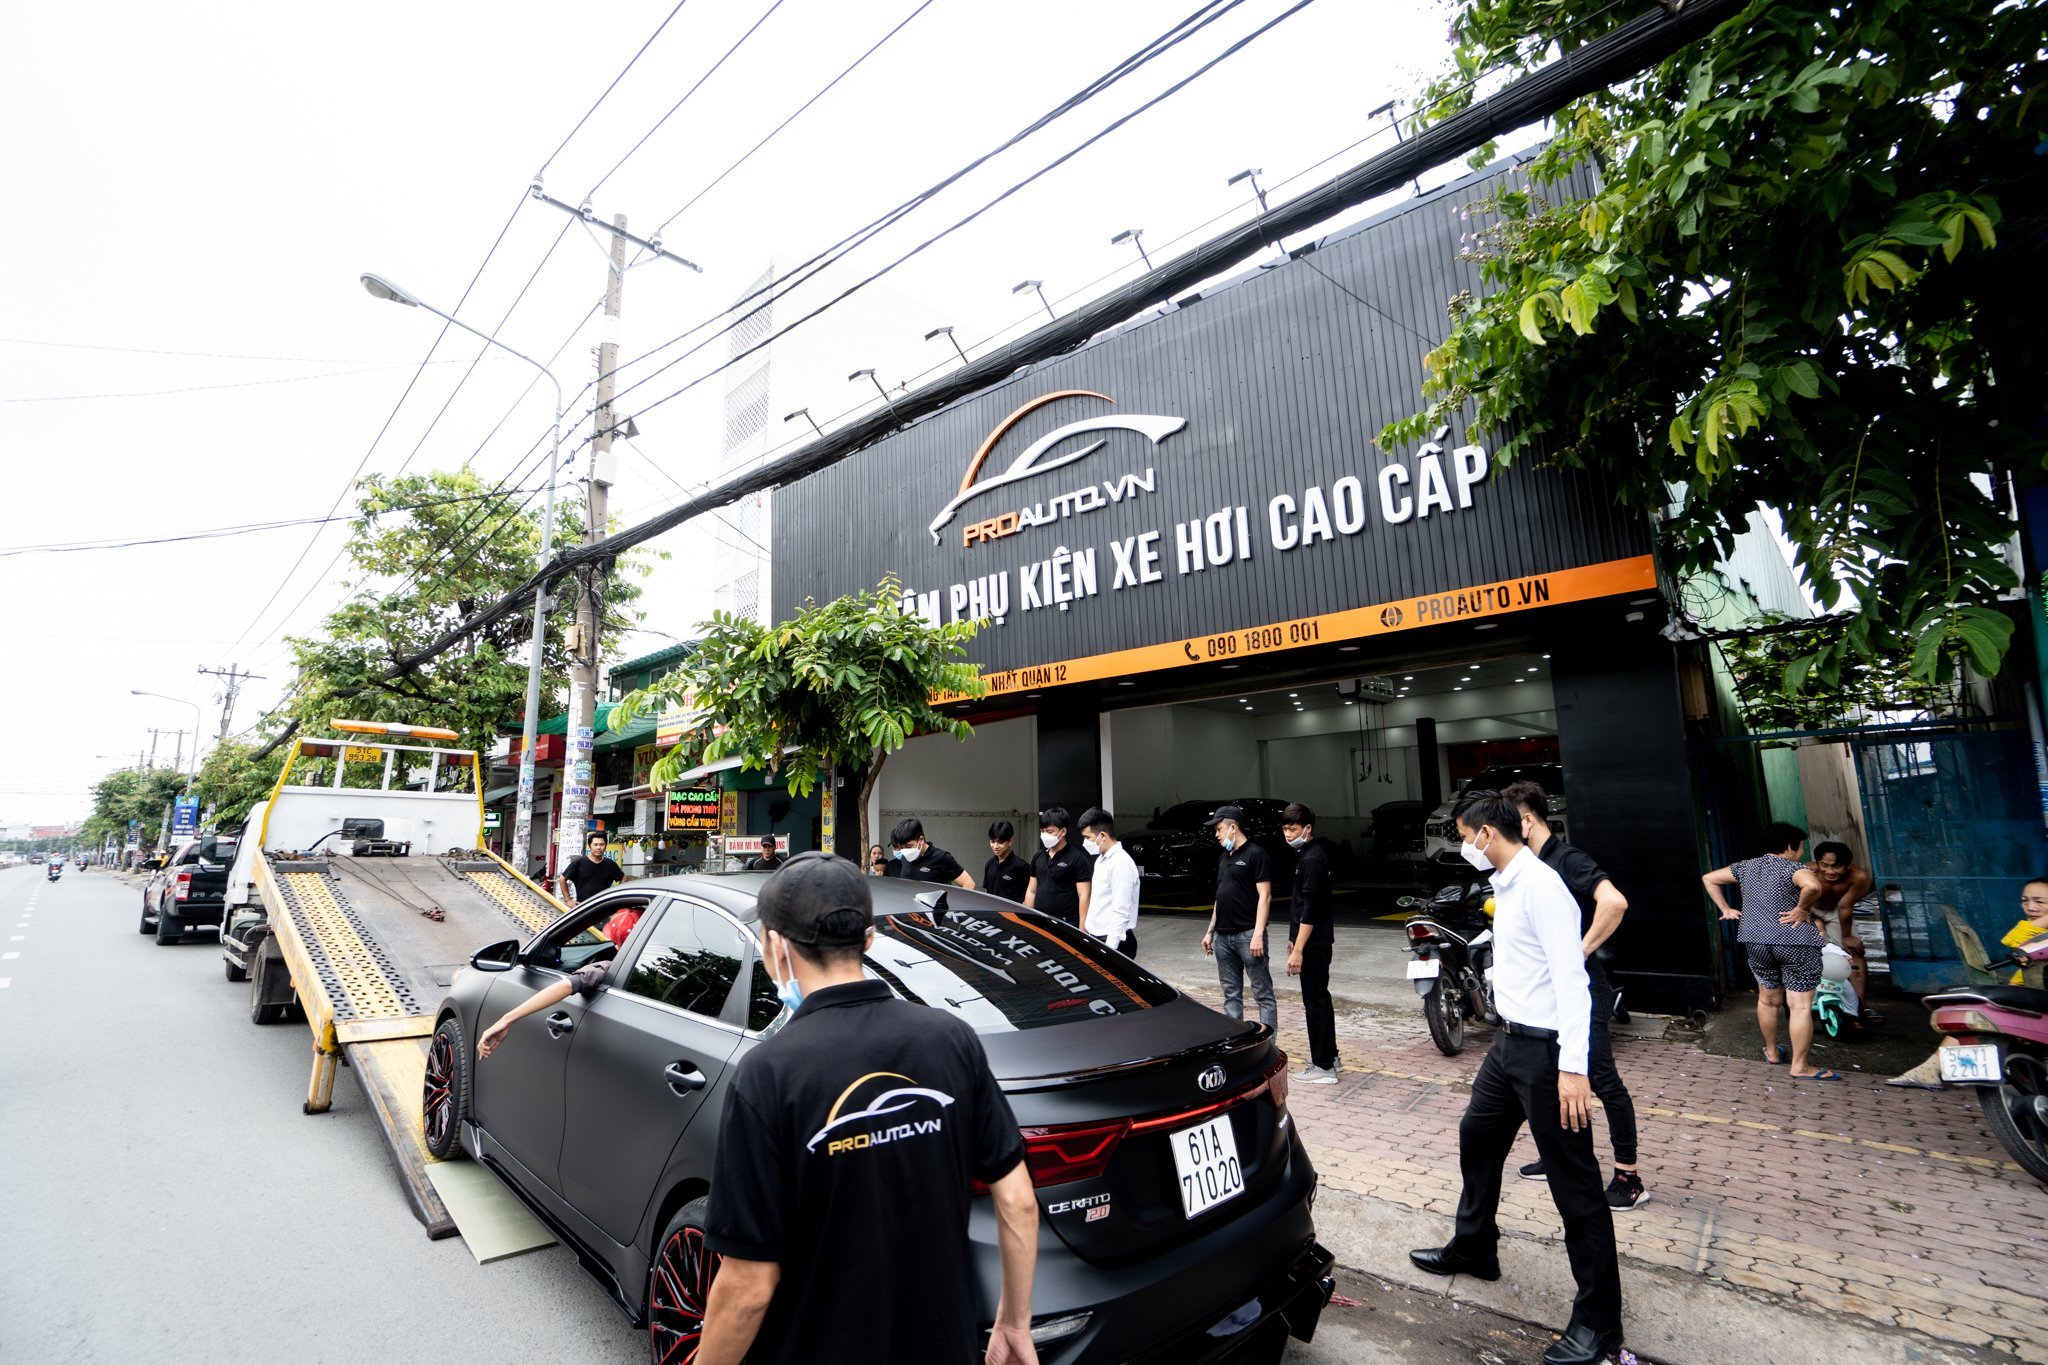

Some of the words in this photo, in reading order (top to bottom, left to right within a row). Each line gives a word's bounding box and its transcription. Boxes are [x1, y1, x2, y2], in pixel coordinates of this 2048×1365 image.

[963, 468, 1157, 547] PROAUTO.VN
[950, 571, 1009, 626] PHỤ
[1020, 545, 1099, 613] KIỆN
[1110, 530, 1163, 590] XE
[1176, 506, 1251, 576] HƠI
[1268, 475, 1366, 551] CAO
[1378, 425, 1489, 525] CẤP
[1207, 635, 1237, 658] 090
[1245, 627, 1282, 651] 1800
[1290, 620, 1319, 643] 001
[1021, 666, 1051, 688] QUẬN
[1054, 665, 1067, 681] 12
[356, 747, 372, 755] 51C
[687, 792, 704, 801] CAO
[1205, 1069, 1225, 1089] KIA
[1950, 1064, 1988, 1078] 2201
[828, 1118, 942, 1156] PROAUTO.VN
[1188, 1124, 1223, 1166] 61A
[1183, 1156, 1241, 1212] 710.20
[1049, 1193, 1111, 1214] CERATO
